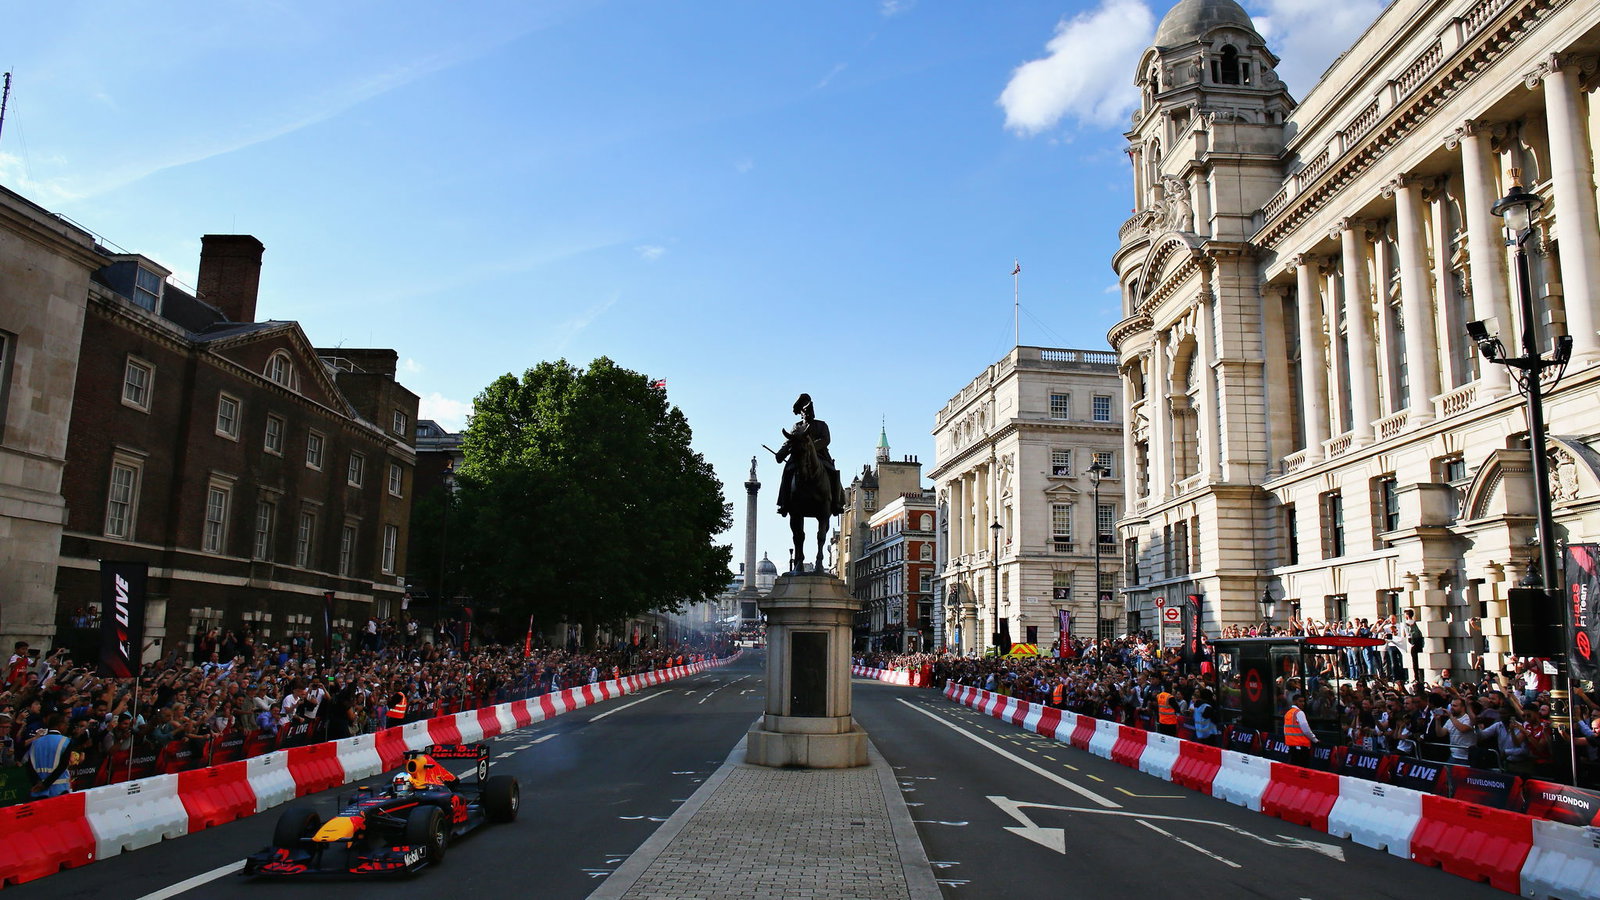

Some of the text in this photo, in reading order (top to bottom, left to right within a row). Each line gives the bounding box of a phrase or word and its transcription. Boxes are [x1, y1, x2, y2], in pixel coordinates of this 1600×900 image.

[115, 573, 129, 628] LIVE
[1572, 583, 1580, 627] Haas
[1581, 615, 1587, 627] F1
[1238, 732, 1253, 743] LIVE
[1274, 742, 1290, 754] LIVE
[1314, 747, 1331, 760] LIVE
[1357, 755, 1378, 770] LIVE
[1409, 765, 1437, 781] LIVE
[404, 848, 420, 867] Mobil
